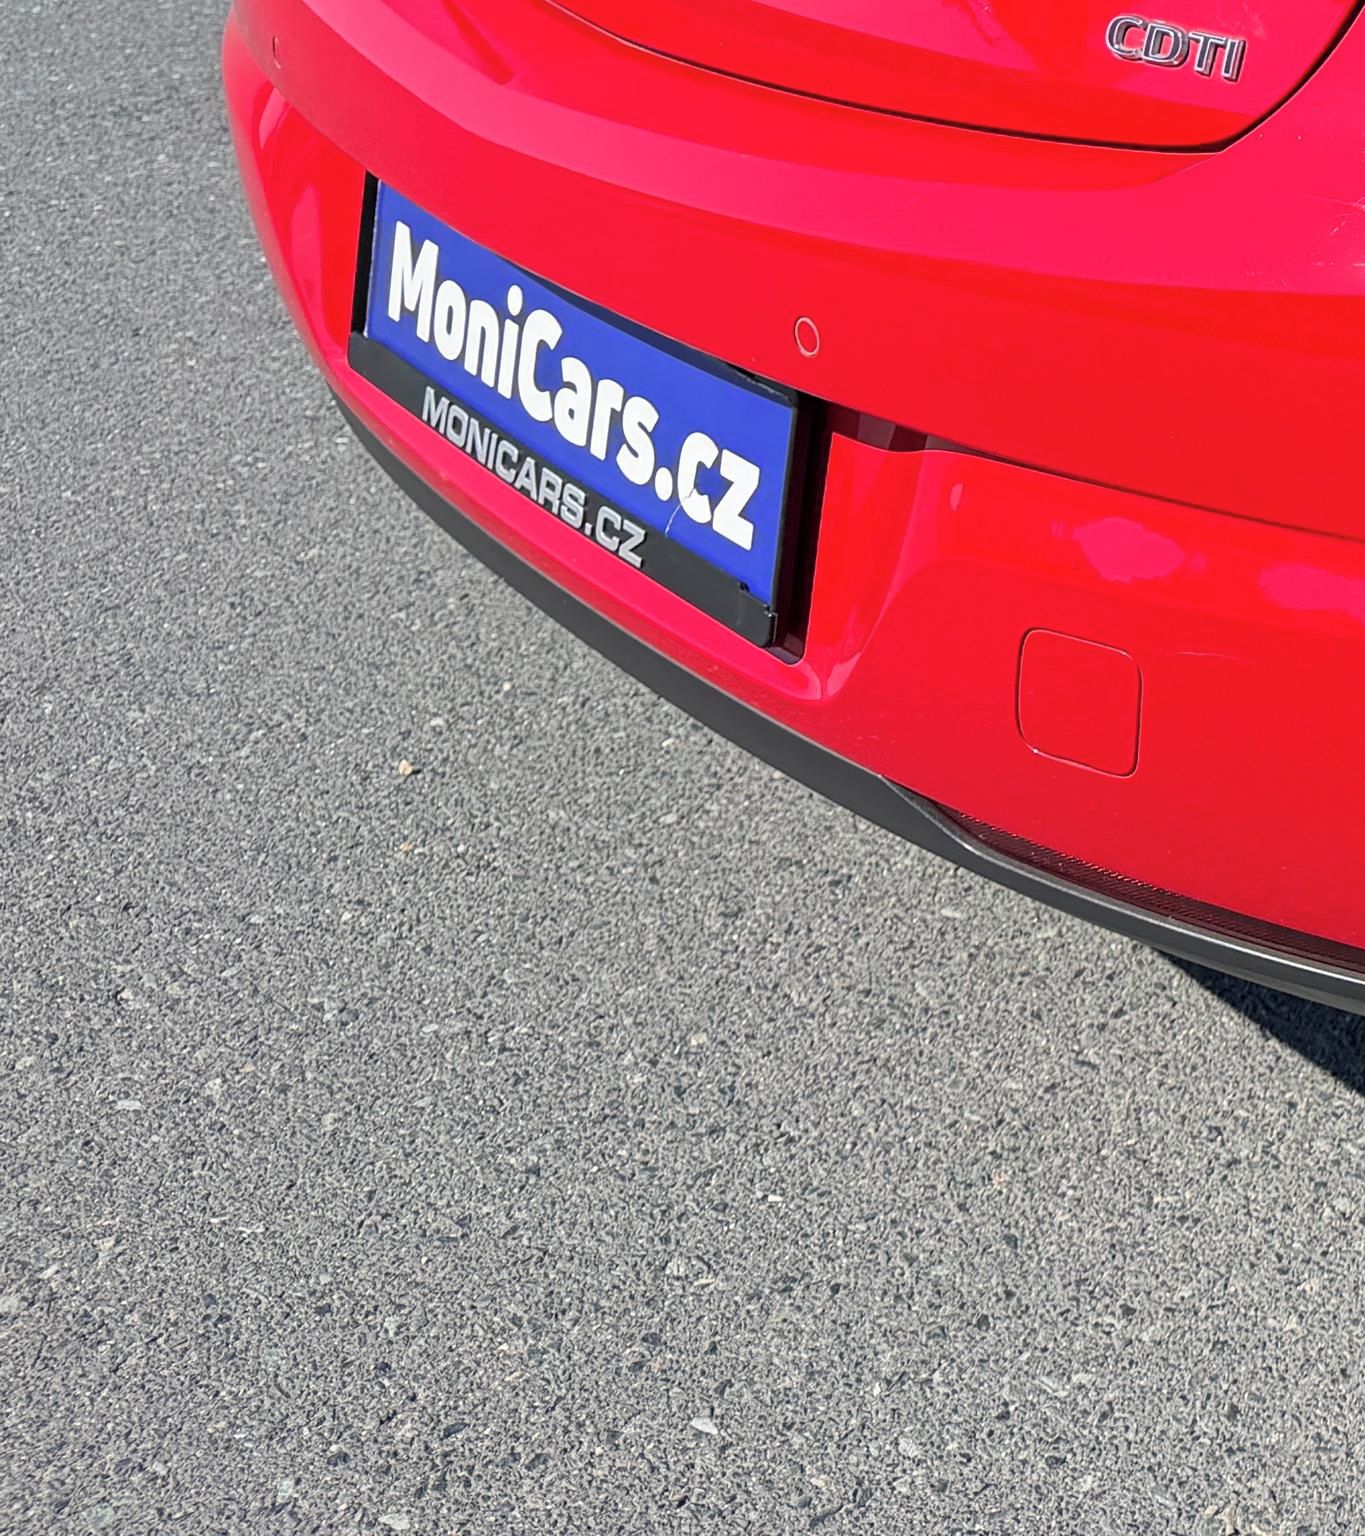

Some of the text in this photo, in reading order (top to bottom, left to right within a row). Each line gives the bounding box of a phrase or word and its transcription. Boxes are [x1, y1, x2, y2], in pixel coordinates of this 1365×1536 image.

[1105, 14, 1246, 82] CDTI
[387, 220, 761, 551] MoniCars.cz
[421, 386, 648, 570] MONICARS.CZ
